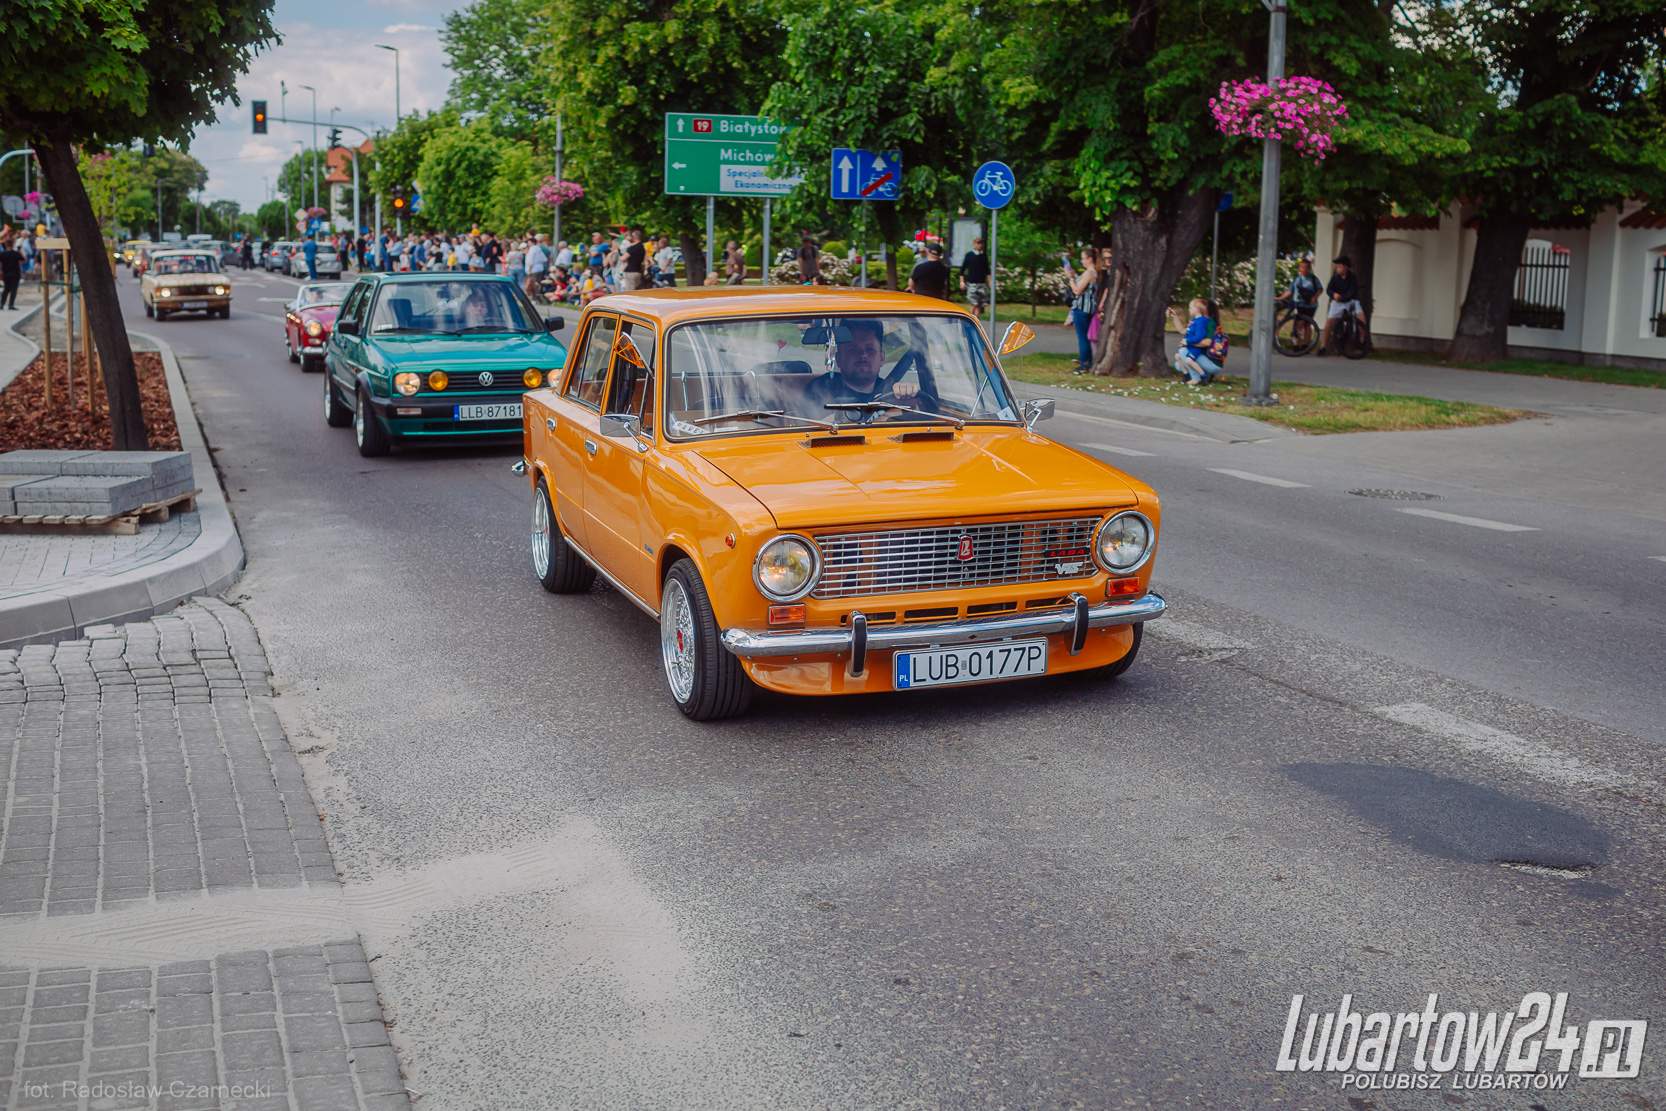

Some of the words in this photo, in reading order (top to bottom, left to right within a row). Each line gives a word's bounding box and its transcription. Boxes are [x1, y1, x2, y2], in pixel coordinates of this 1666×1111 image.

[697, 121, 709, 131] 19
[460, 406, 483, 419] LLB
[487, 404, 522, 418] 87181
[912, 653, 960, 683] LUB
[968, 645, 1042, 677] 0177P
[899, 674, 909, 683] PL
